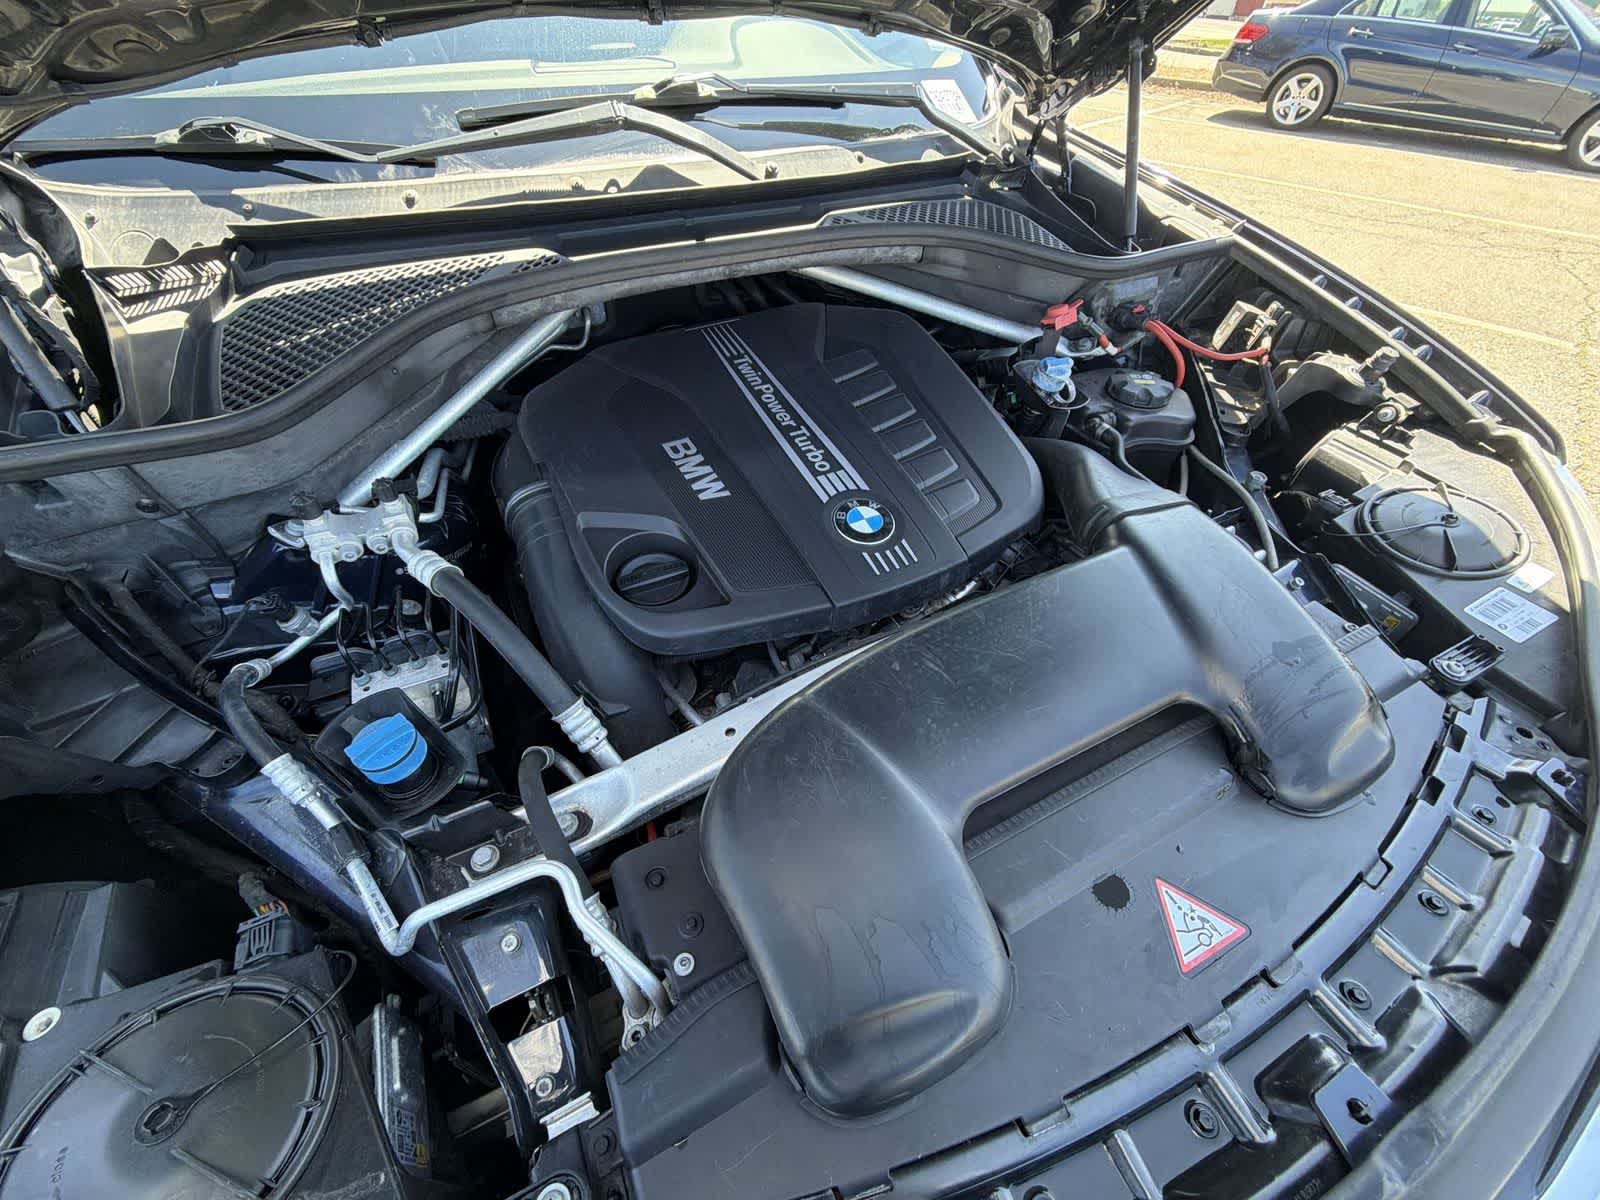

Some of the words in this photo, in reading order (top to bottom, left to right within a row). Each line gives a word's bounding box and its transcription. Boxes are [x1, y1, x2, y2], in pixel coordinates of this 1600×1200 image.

[734, 354, 796, 426] TwinPower
[789, 426, 831, 472] Turbo
[662, 437, 732, 501] BMW
[837, 500, 881, 520] BMW
